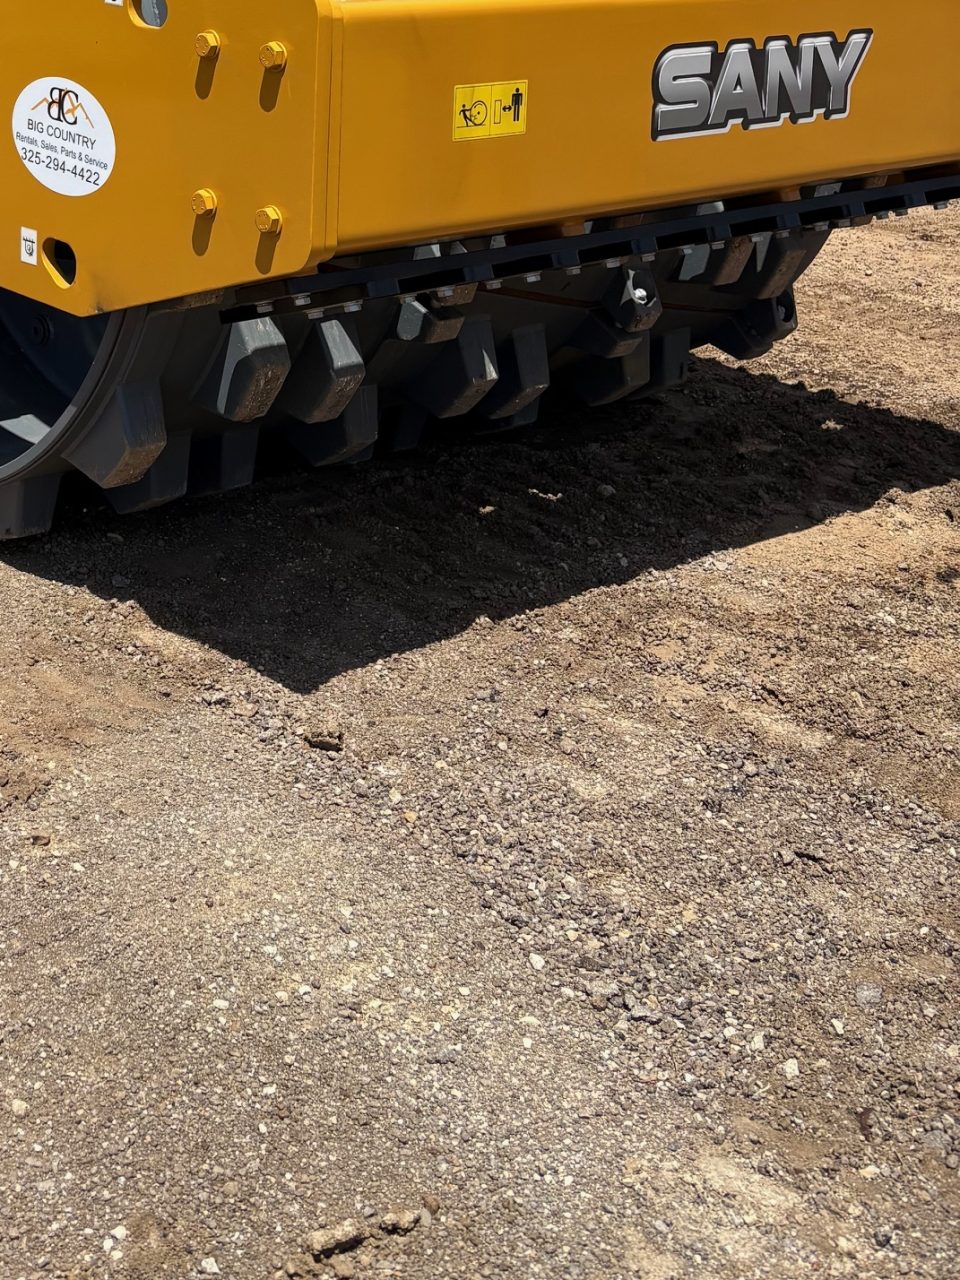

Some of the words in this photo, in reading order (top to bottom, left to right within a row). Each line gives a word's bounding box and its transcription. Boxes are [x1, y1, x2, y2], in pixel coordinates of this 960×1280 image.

[652, 29, 872, 140] SANY
[16, 131, 39, 147] Rentals,
[41, 139, 59, 154] Sales,
[60, 146, 77, 160] Parts
[77, 152, 83, 162] &
[84, 154, 109, 170] Service
[27, 118, 44, 134] BIG
[46, 124, 97, 151] COUNTRY
[21, 147, 101, 186] 325-294-4422
